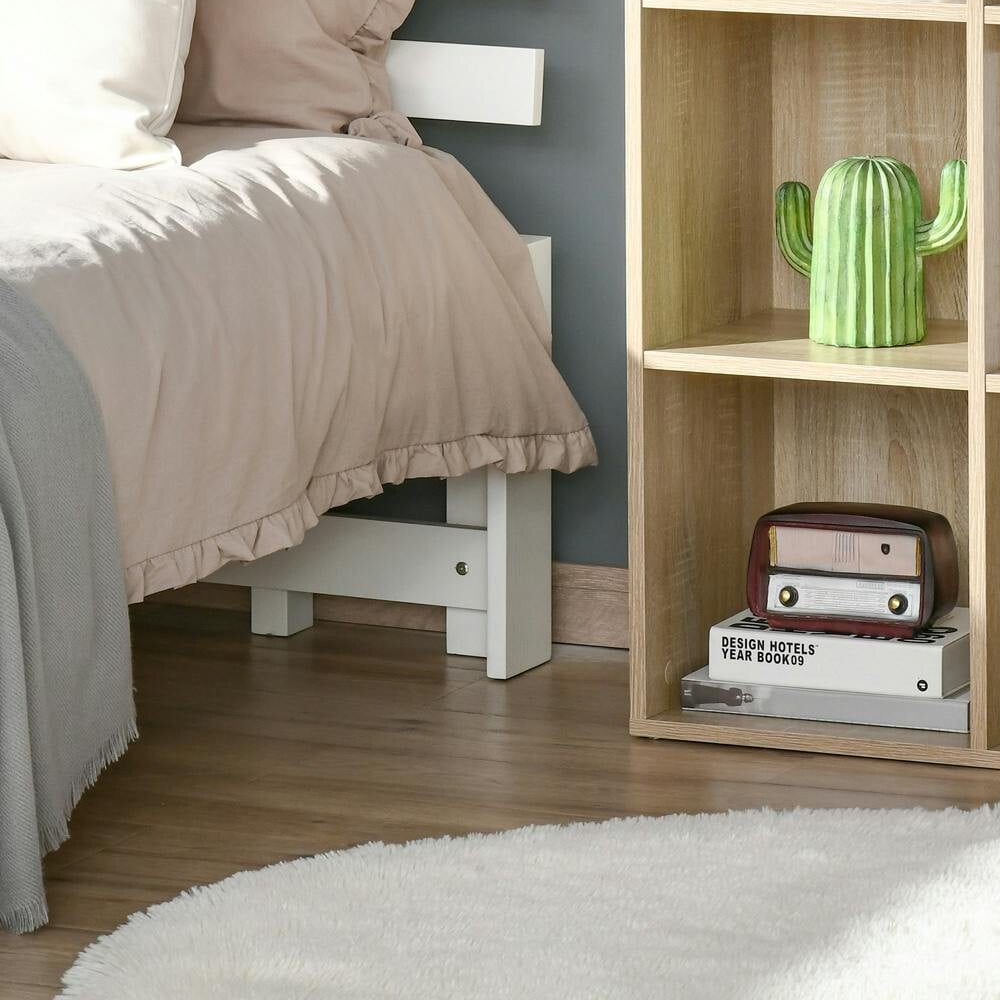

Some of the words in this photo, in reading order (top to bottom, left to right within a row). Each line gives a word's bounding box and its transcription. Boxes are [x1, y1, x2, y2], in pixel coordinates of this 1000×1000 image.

[721, 636, 765, 651] DESIGN
[770, 640, 815, 655] HOTELS
[722, 648, 752, 662] YEAR
